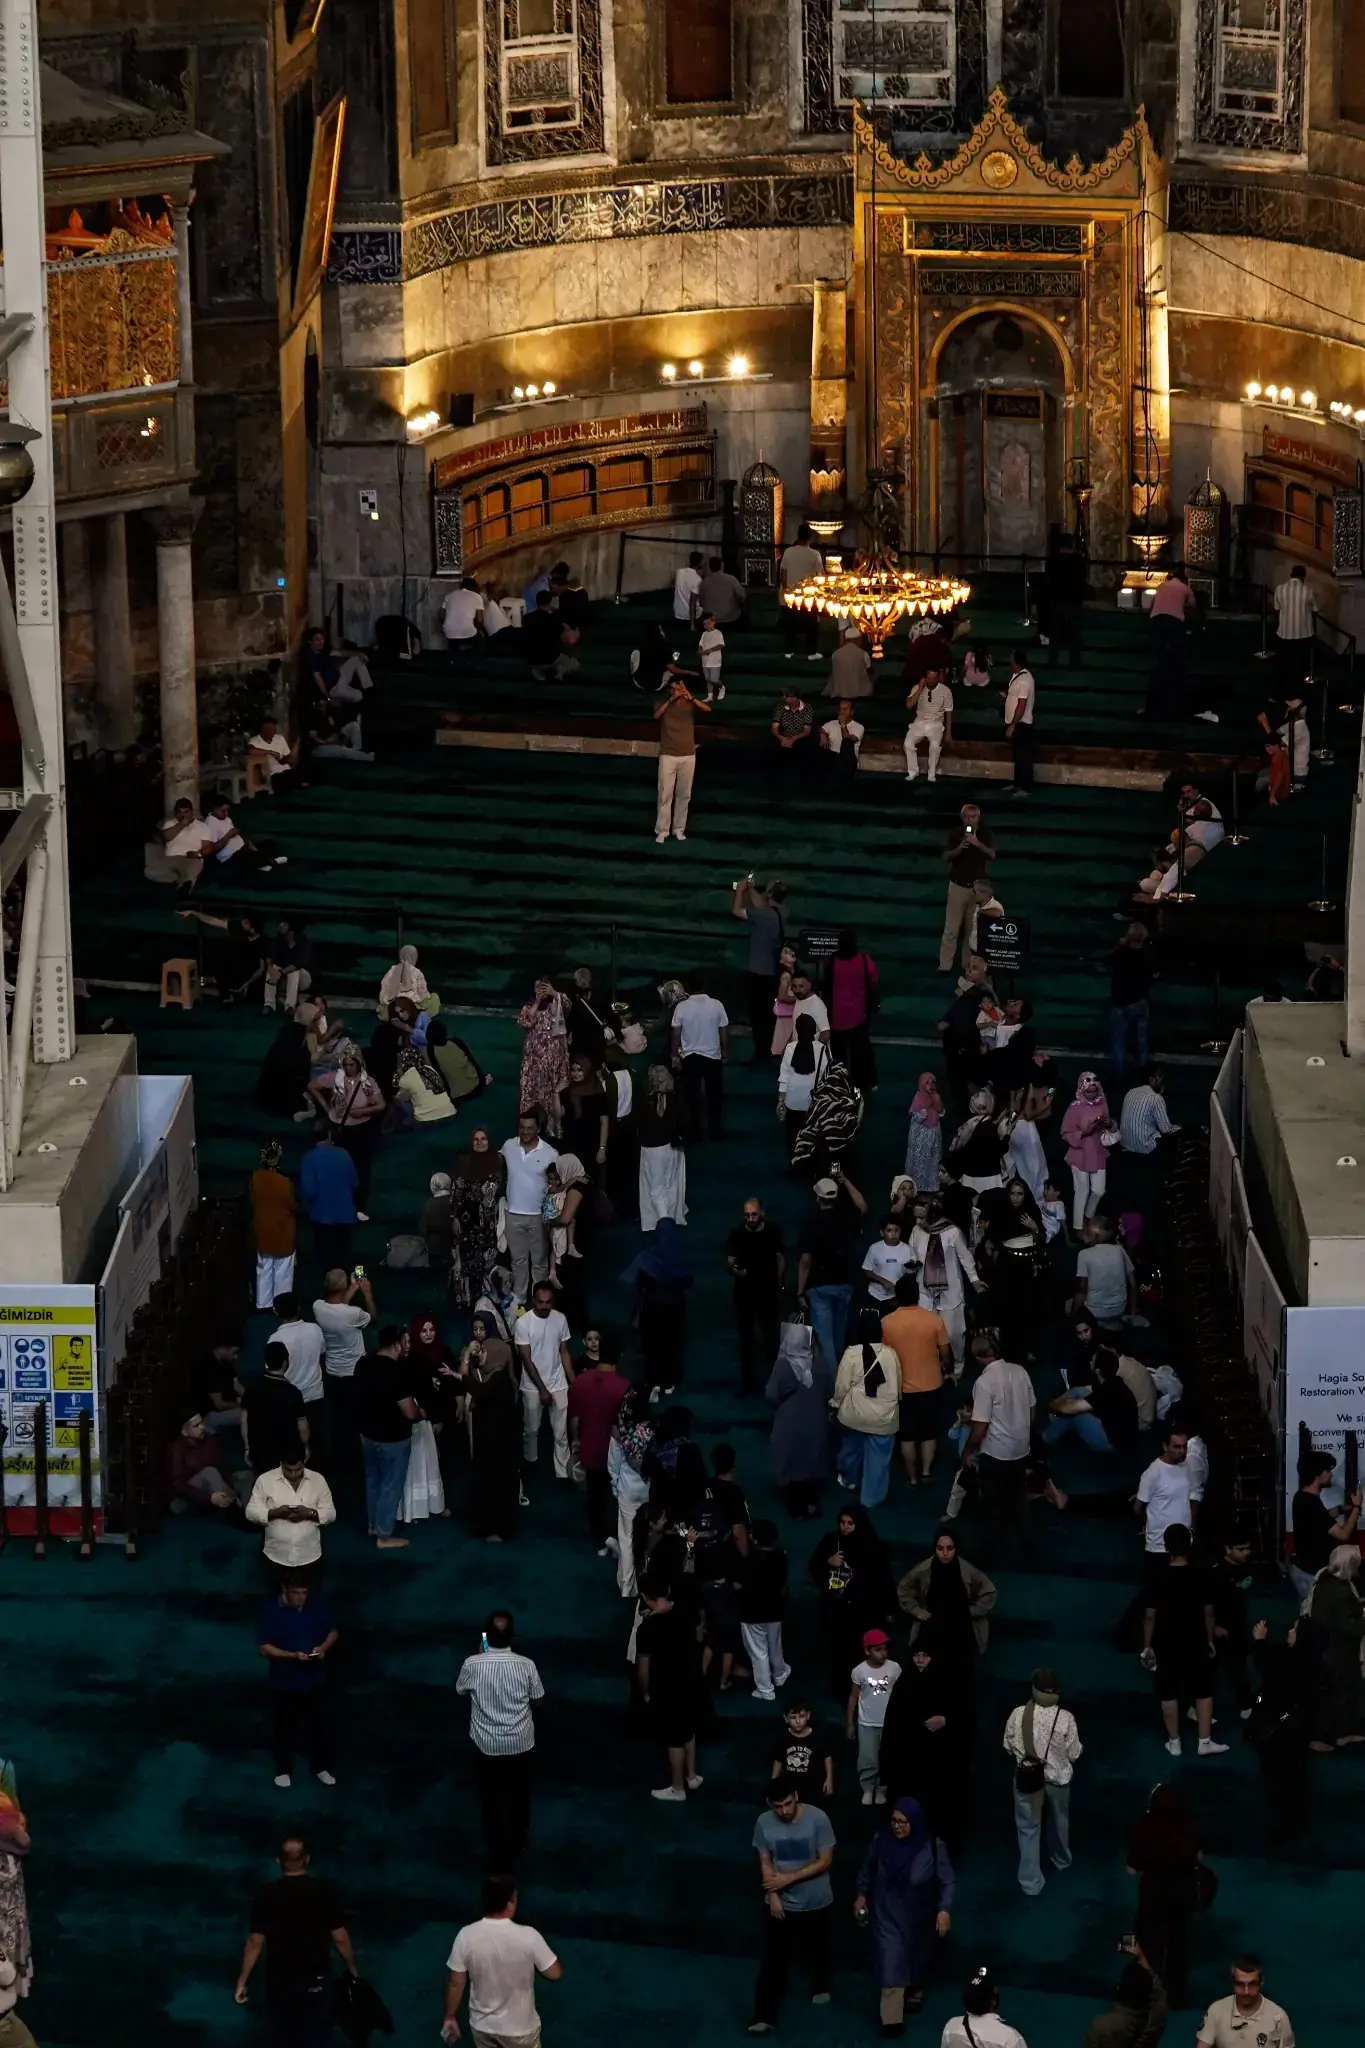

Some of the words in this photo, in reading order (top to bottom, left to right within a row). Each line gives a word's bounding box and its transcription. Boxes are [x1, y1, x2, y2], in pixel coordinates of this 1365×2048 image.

[1319, 1373, 1348, 1384] Hagia
[1300, 1387, 1355, 1396] Restoration
[1336, 1413, 1352, 1422] We
